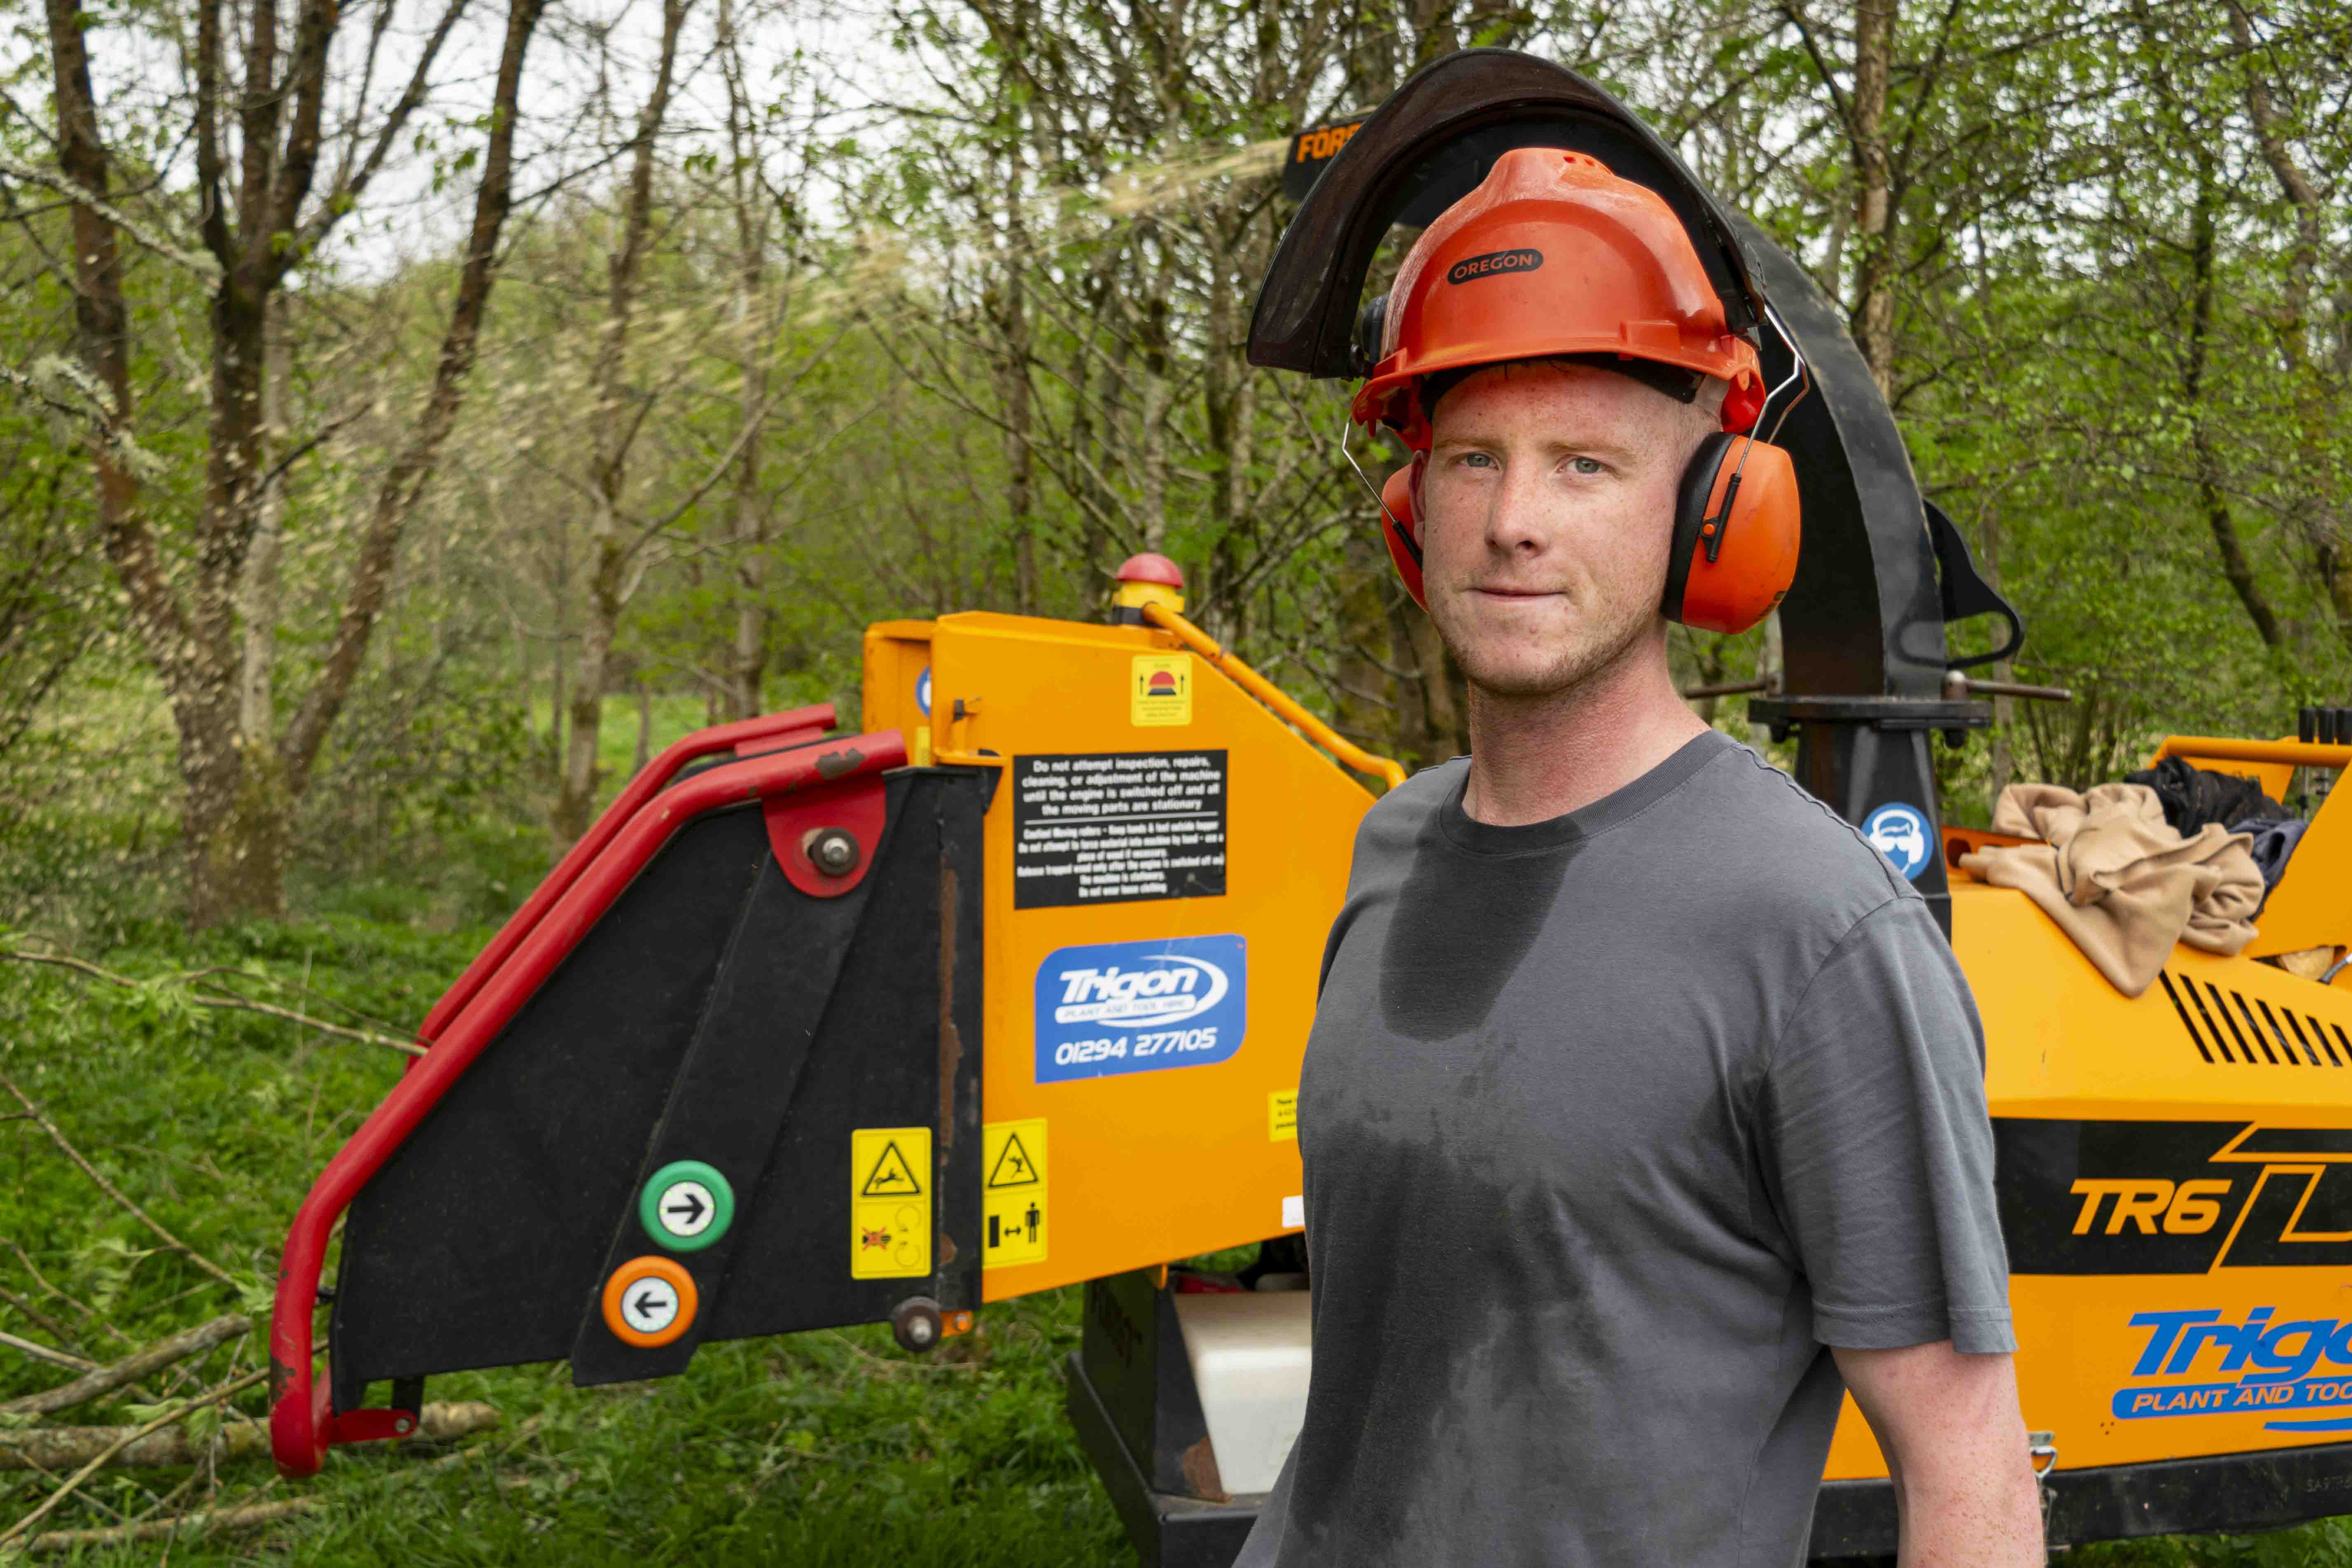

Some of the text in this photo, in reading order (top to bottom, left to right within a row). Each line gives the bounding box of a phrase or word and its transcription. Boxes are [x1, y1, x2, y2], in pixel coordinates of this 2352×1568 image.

[1454, 253, 1533, 279] OREGON
[1033, 760, 1049, 772] Do
[1051, 761, 1070, 771] not
[1072, 759, 1113, 772] attempt
[1071, 776, 1083, 786] or
[1086, 772, 1143, 786] adjustment
[1145, 771, 1158, 783] of
[1160, 771, 1177, 782] the
[1180, 770, 1221, 781] machine
[1023, 783, 1220, 802] until the engine is switched off and all
[1041, 798, 1203, 815] the moving parts are stationary
[1060, 967, 1198, 1004] Trigon
[1055, 1027, 1218, 1065] 01294 277105
[2069, 1178, 2233, 1235] TR6
[2132, 1389, 2230, 1413] PLANT
[2233, 1385, 2294, 1406] AND
